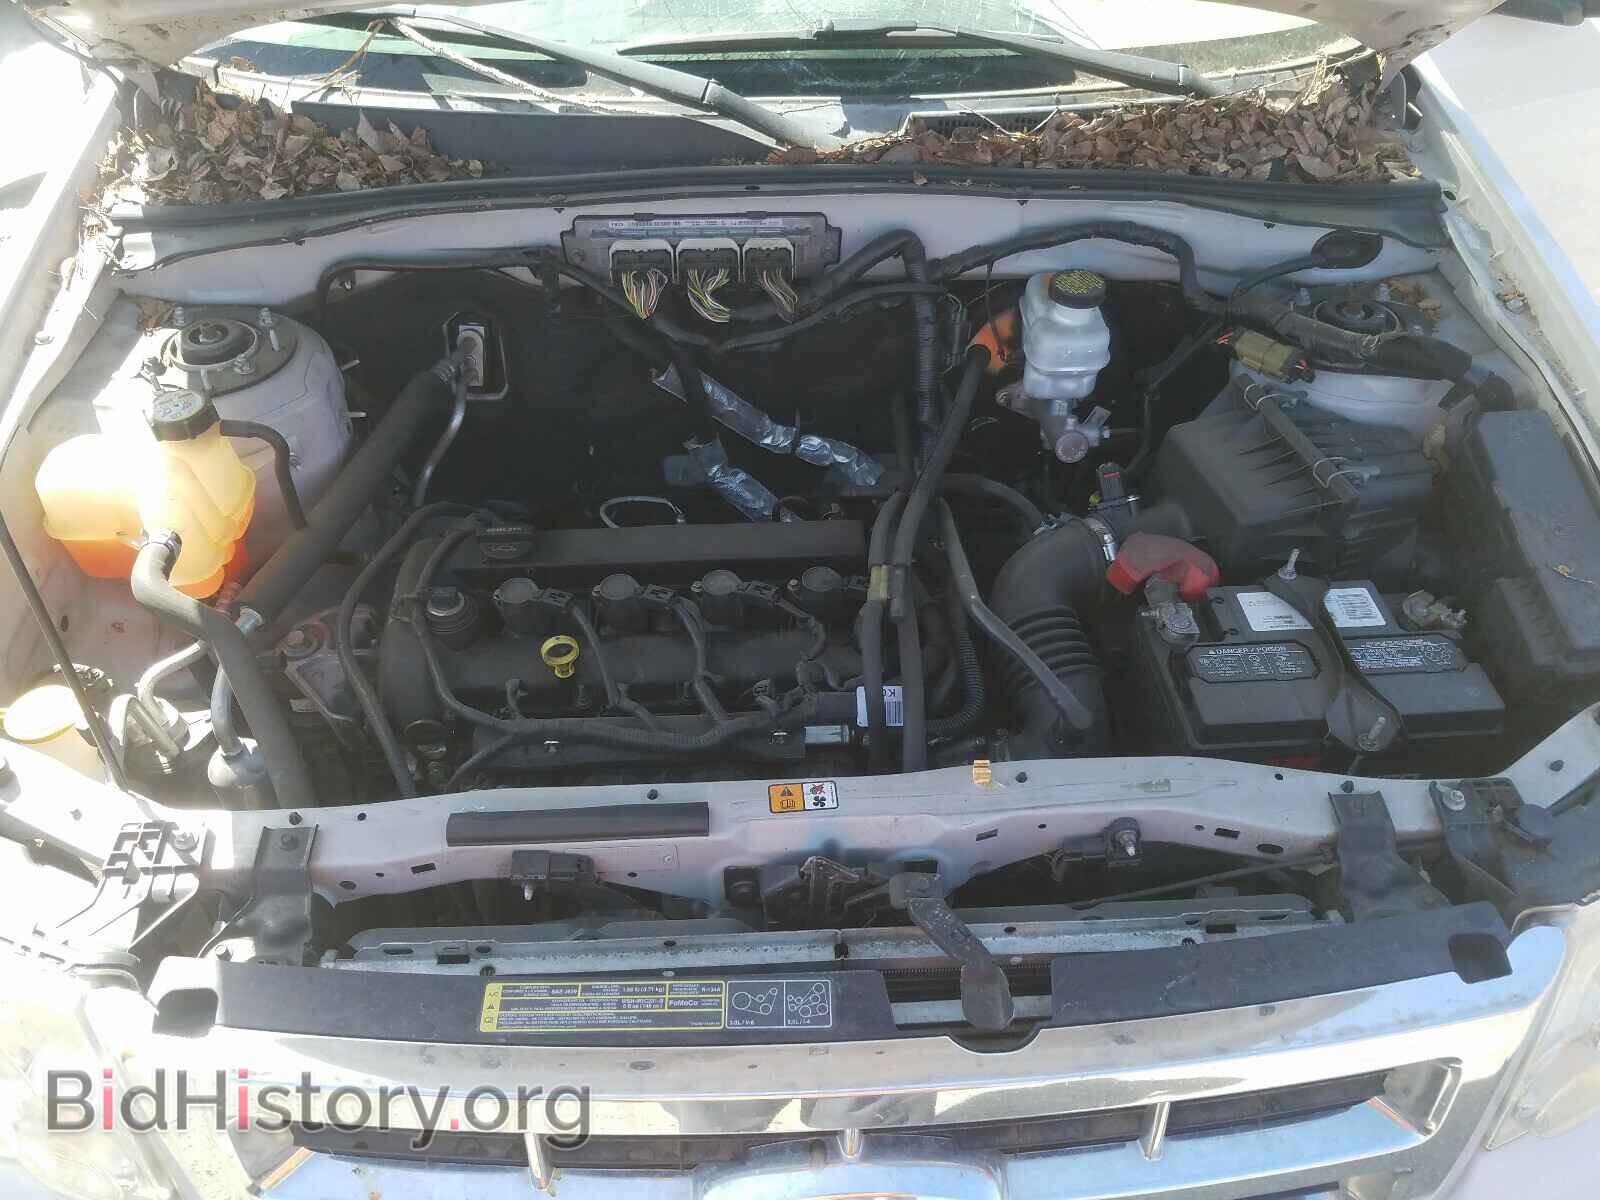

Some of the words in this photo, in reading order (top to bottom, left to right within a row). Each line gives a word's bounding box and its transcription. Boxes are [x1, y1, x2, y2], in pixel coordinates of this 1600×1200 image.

[1216, 647, 1248, 655] DANGER
[1256, 645, 1287, 653] POISON
[669, 999, 698, 1007] FoMoCo
